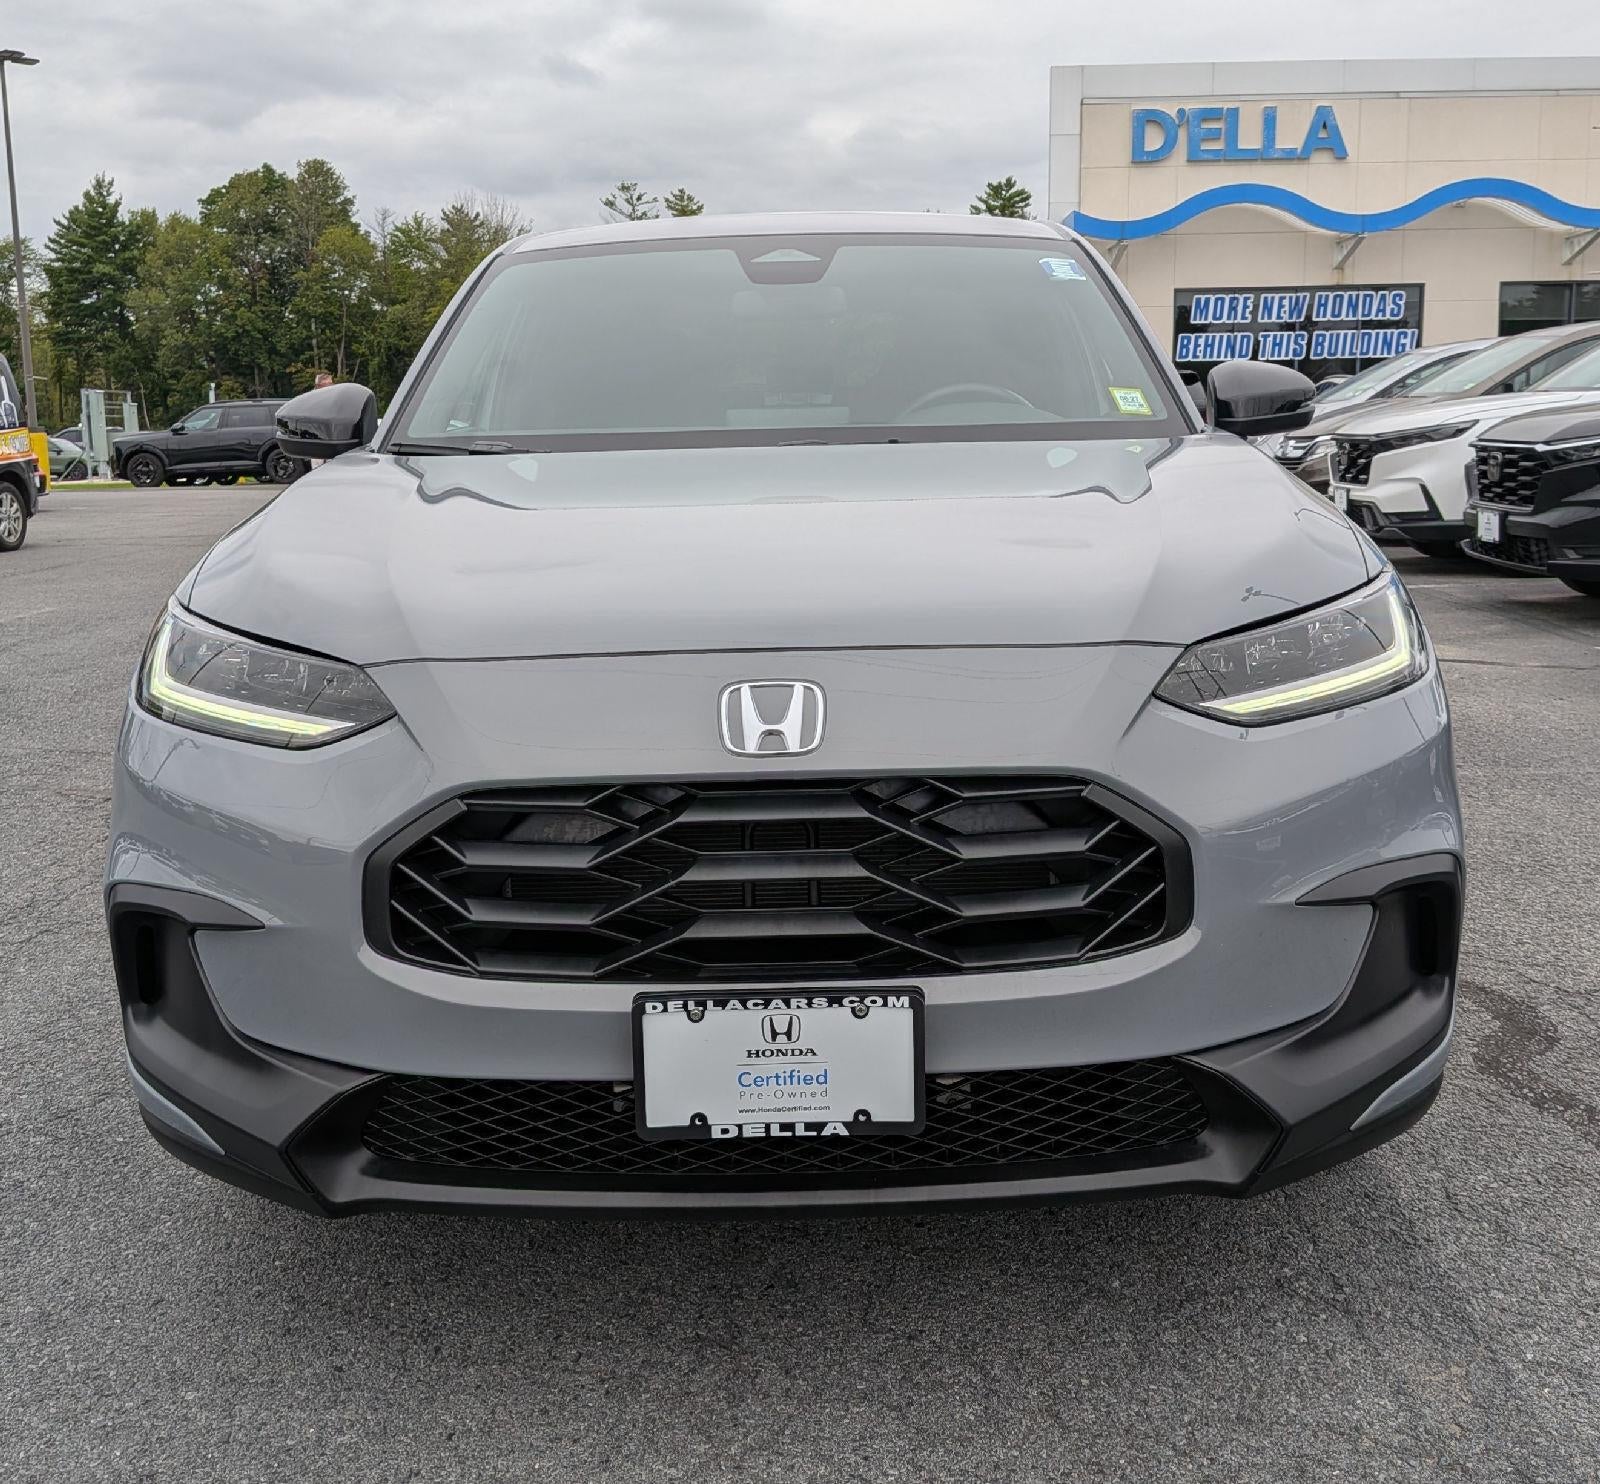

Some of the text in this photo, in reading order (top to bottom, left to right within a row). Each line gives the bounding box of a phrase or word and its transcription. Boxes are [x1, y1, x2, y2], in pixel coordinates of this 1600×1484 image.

[1131, 105, 1348, 163] D'ELLA
[1190, 291, 1405, 324] MORE NEW HONDAS
[1176, 329, 1418, 361] BEHIND THIS BUILDING!
[644, 996, 910, 1014] DELLACARS.COM
[746, 1047, 818, 1059] HONDA
[737, 1068, 828, 1088] Certified
[739, 1086, 828, 1101] Pre-Owned
[737, 1104, 831, 1114] www.HondaCertified.com
[710, 1122, 850, 1139] DELLA
